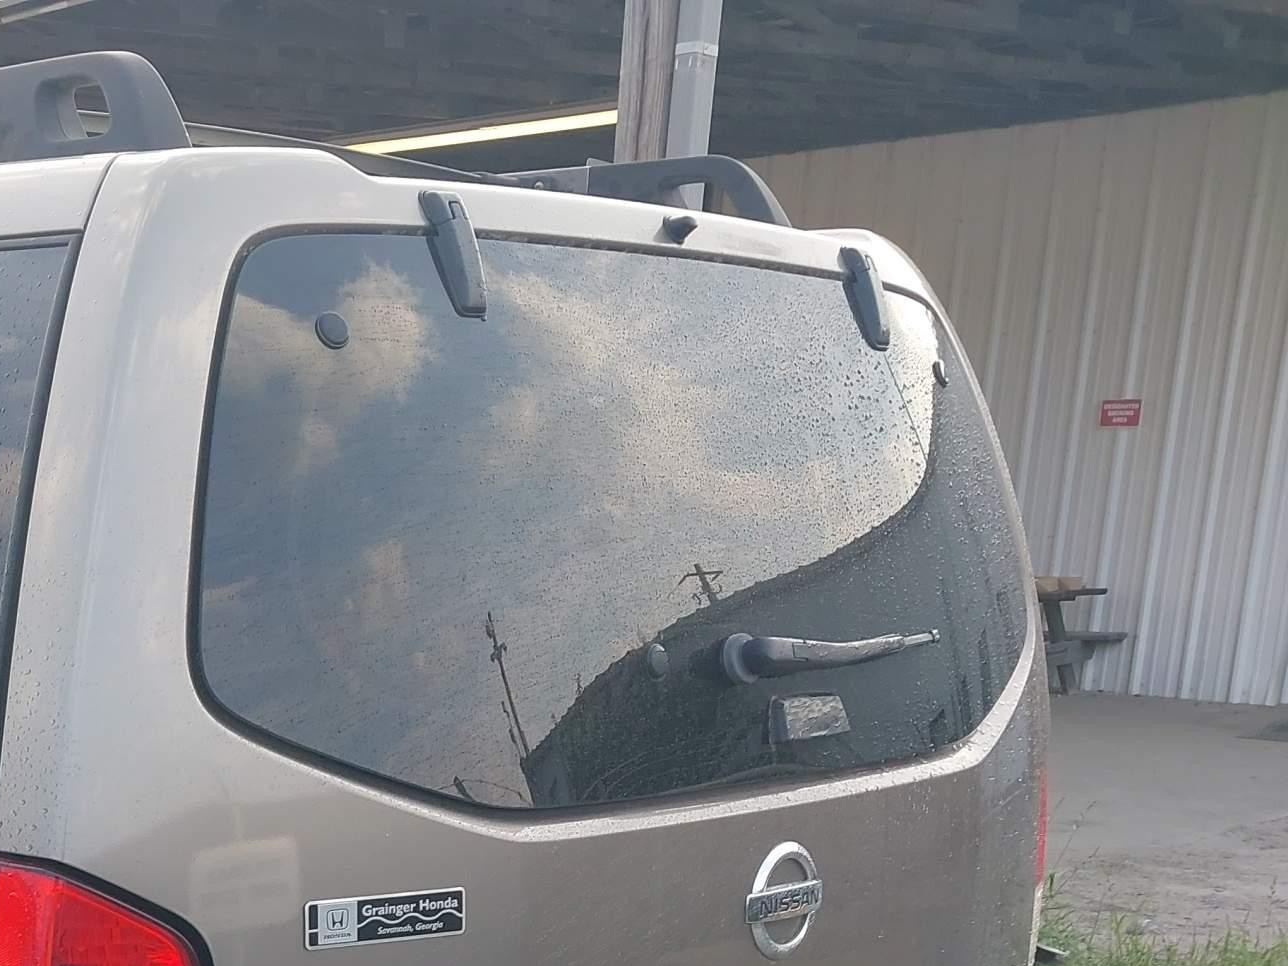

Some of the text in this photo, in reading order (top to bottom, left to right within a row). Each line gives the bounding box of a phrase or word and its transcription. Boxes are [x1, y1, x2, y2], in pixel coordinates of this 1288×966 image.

[362, 897, 458, 917] Grainger Honda
[759, 888, 820, 919] NISSAN
